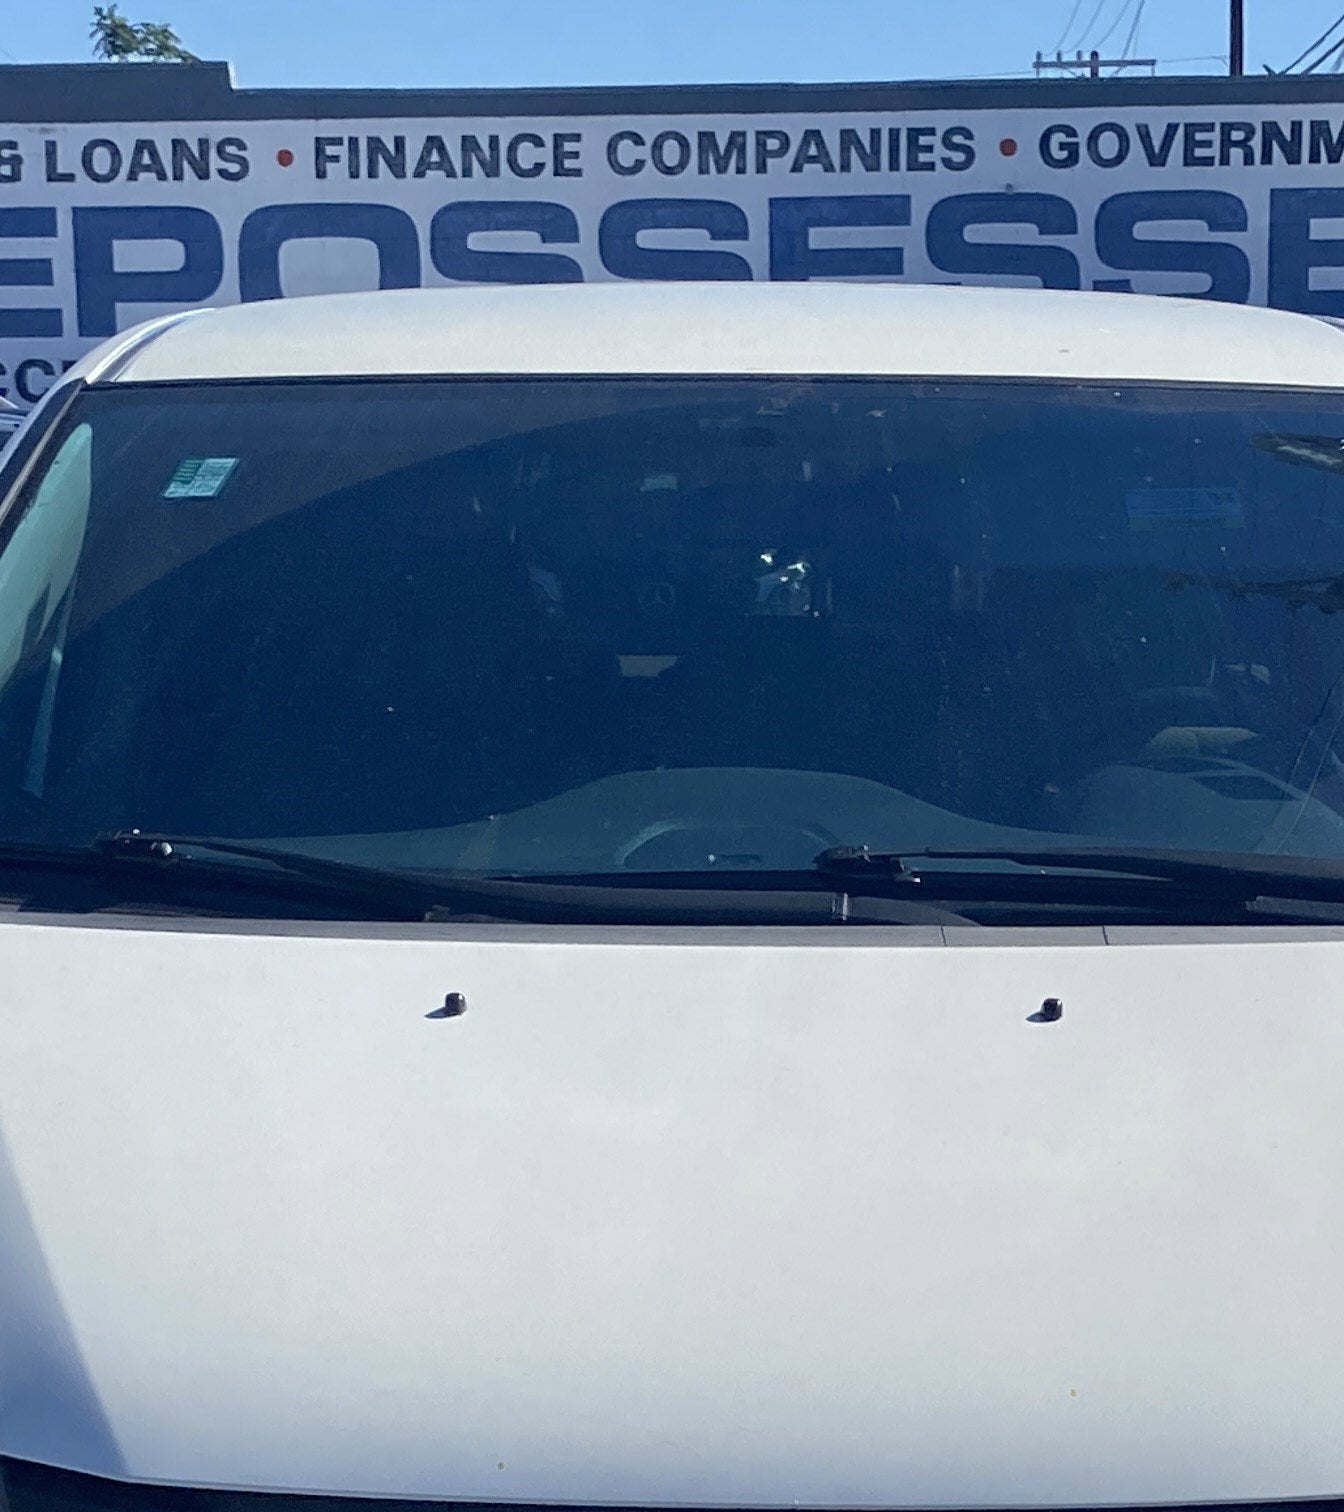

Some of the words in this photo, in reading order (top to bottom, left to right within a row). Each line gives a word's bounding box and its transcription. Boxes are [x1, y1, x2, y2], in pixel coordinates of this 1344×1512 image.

[46, 136, 251, 183] LOANS
[313, 132, 583, 180] FINANCE
[606, 126, 976, 176] COMPANIES
